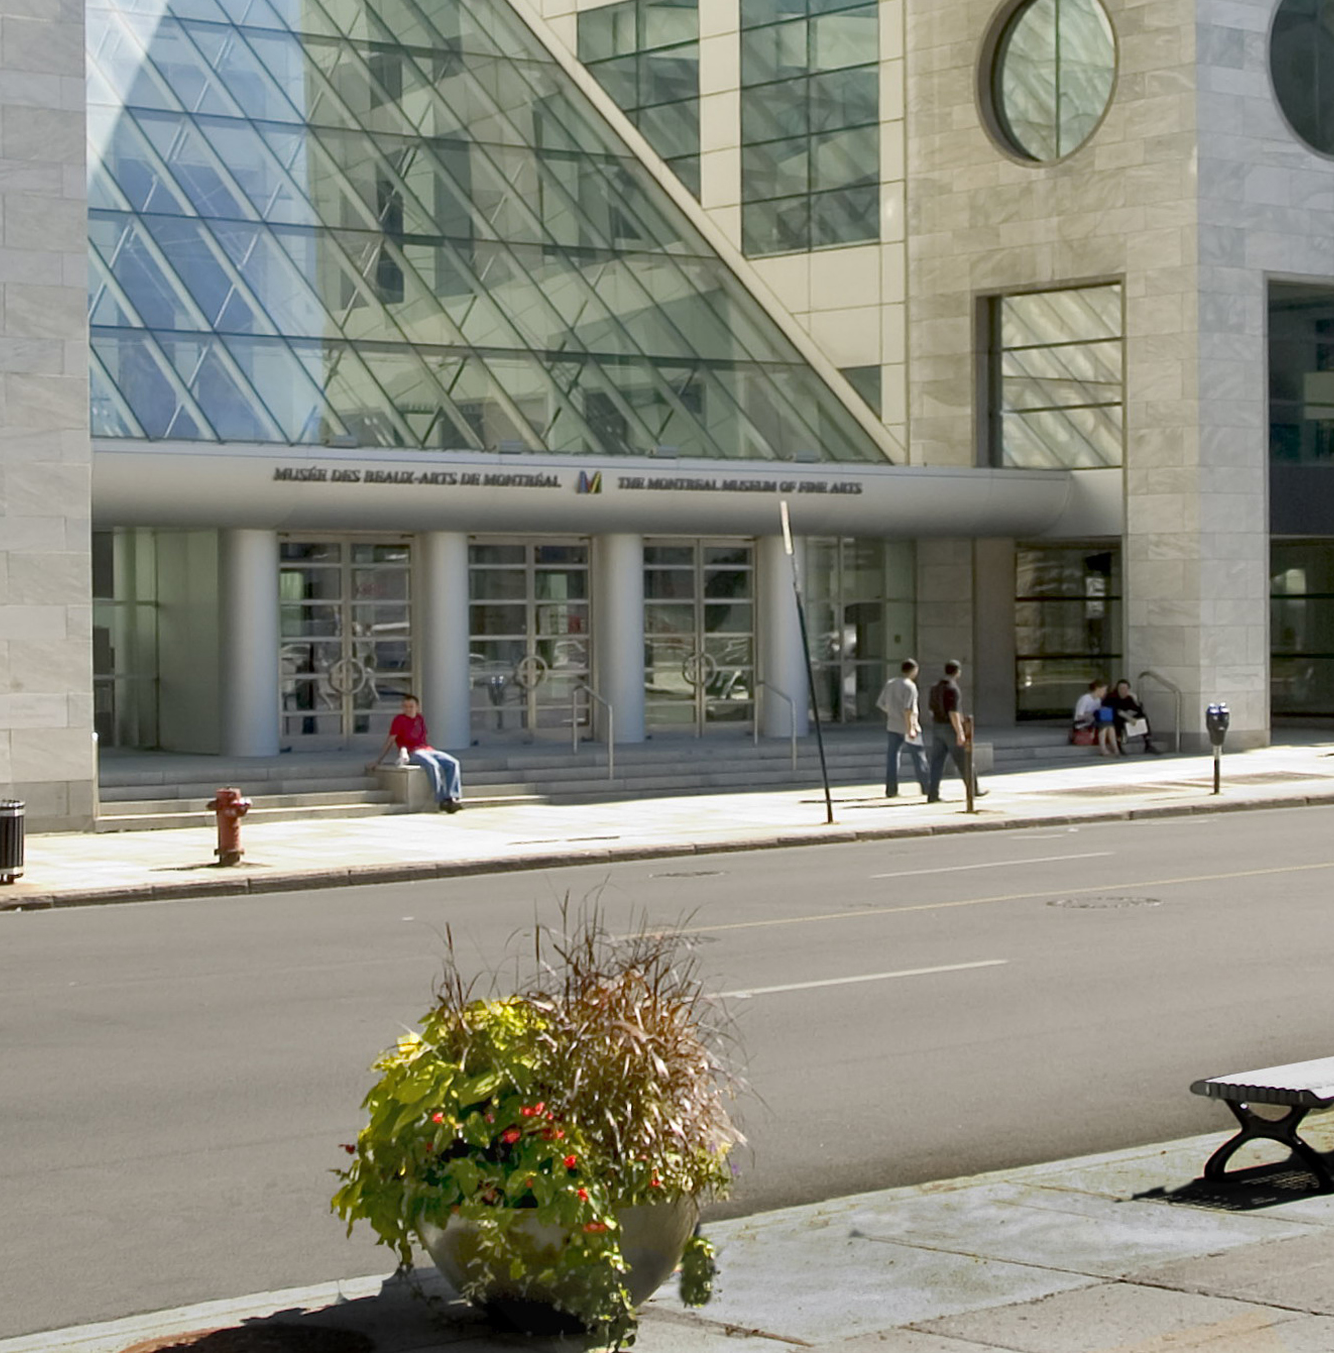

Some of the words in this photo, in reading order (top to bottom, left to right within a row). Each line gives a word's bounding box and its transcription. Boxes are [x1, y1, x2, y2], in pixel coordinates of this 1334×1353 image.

[273, 466, 327, 482] MUSÉE
[331, 470, 361, 483] DES
[364, 471, 457, 485] BEAUX-ARTS
[460, 473, 480, 486] DE
[483, 472, 562, 488] MONTRÉAL
[618, 477, 645, 490] THE
[647, 478, 720, 492] MONTREAL
[722, 479, 777, 492] MUSEUM
[779, 481, 797, 493] OF
[798, 481, 827, 494] FINE
[830, 482, 863, 495] ARTS
